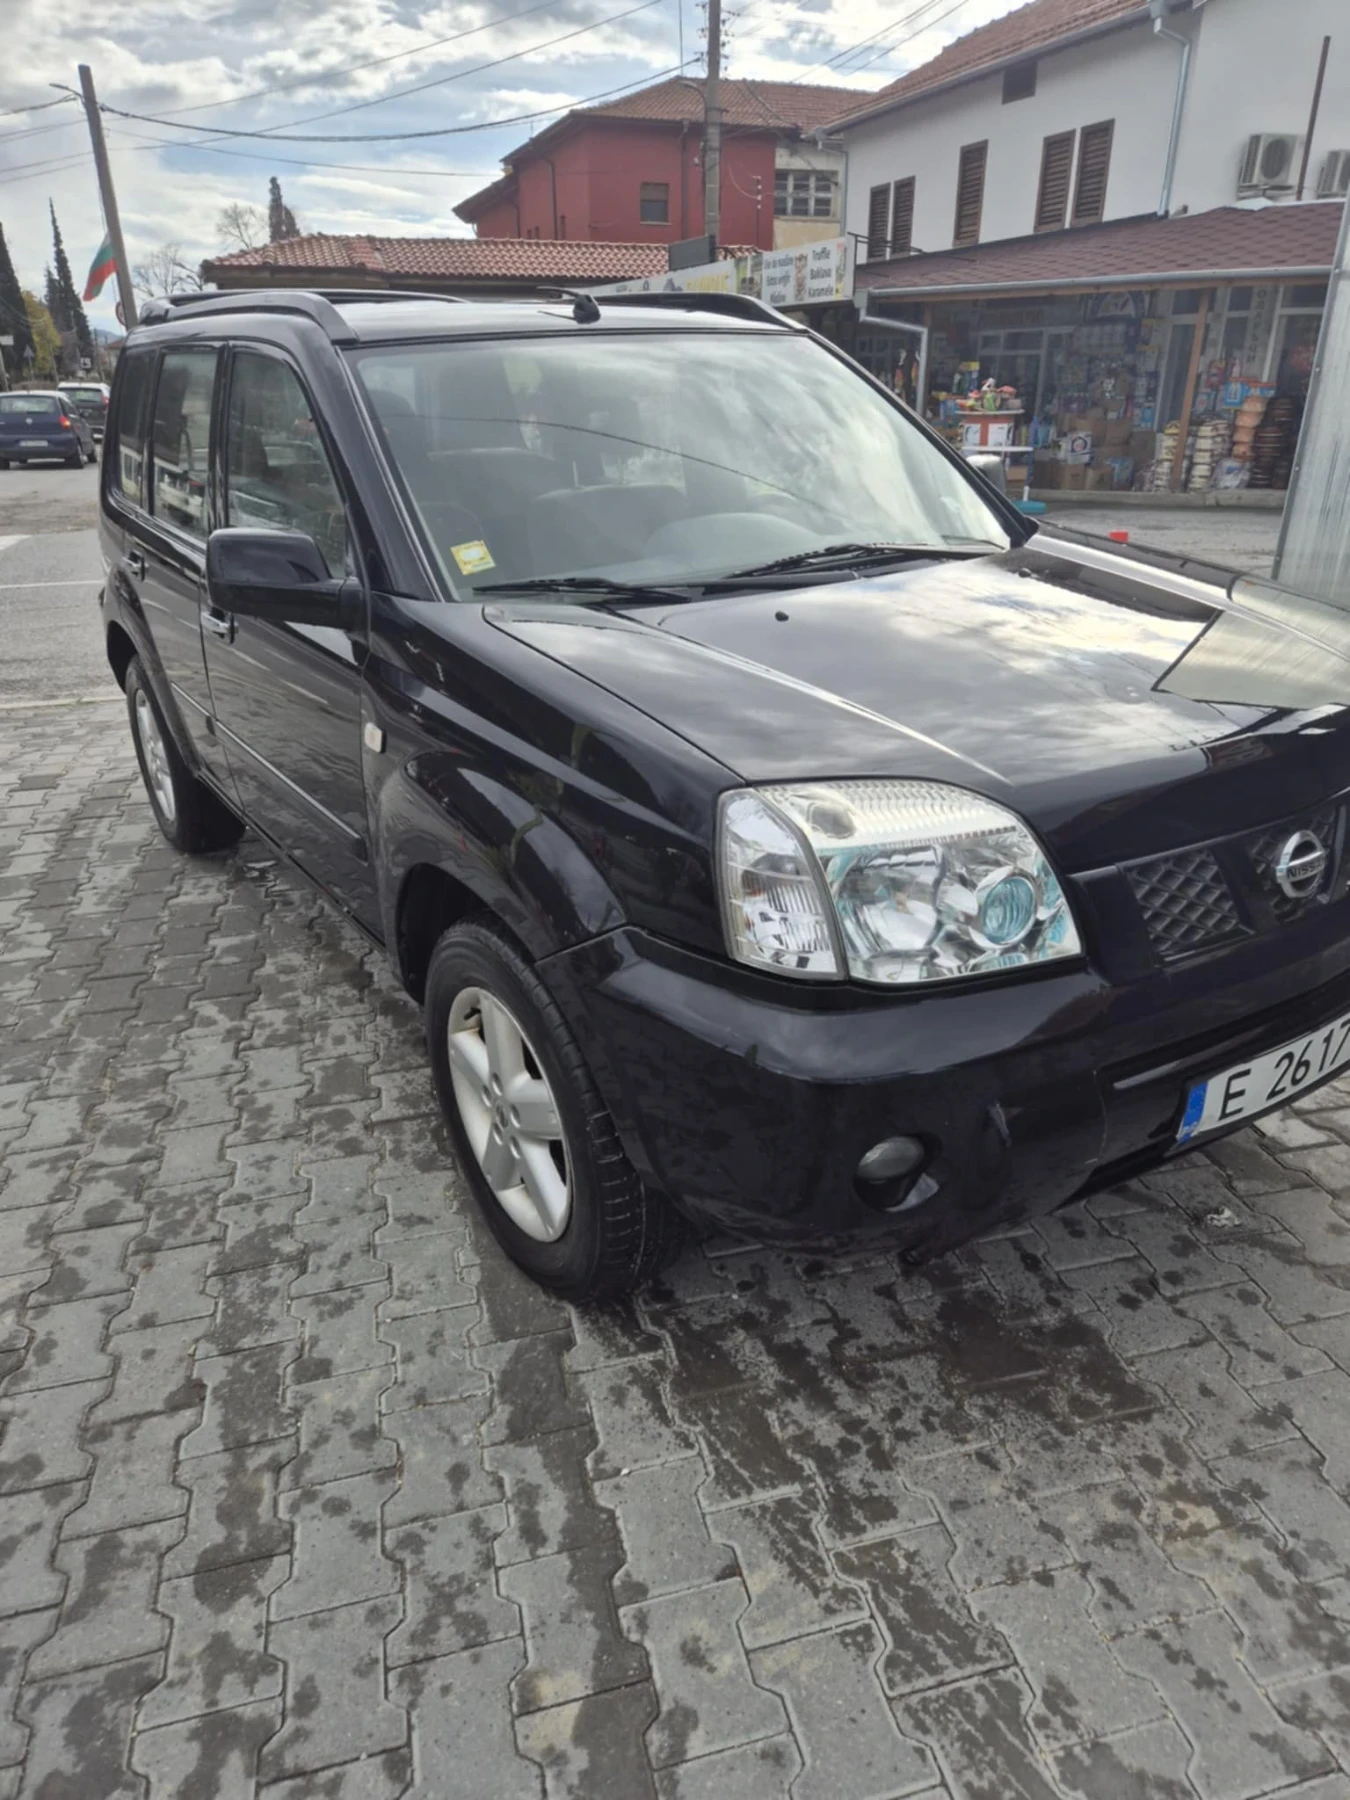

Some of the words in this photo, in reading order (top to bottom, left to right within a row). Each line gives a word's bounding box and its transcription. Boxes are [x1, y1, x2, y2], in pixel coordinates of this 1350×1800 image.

[812, 247, 830, 260] Truffle
[810, 267, 831, 280] Baklava
[808, 284, 834, 297] Karamele
[1219, 1068, 1252, 1121] E
[1266, 1018, 1350, 1101] 2617
